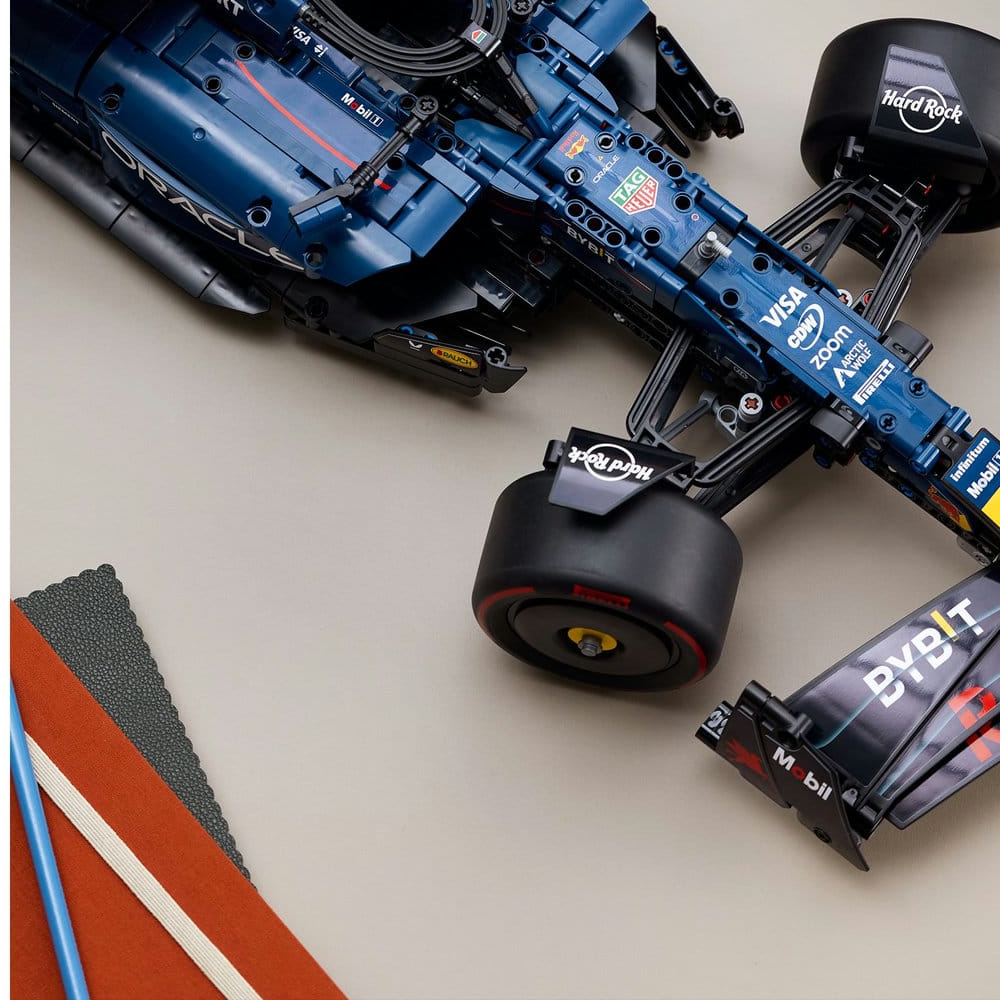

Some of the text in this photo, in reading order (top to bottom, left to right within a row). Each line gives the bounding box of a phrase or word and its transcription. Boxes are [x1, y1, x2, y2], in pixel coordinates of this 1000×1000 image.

[341, 92, 373, 120] Mobil
[881, 89, 963, 124] Hard Rock
[101, 130, 304, 271] ORACLE
[613, 171, 646, 202] TAG
[625, 177, 657, 213] HEUER
[758, 286, 808, 328] VISA
[787, 312, 818, 349] CDW
[809, 325, 853, 371] zoom
[841, 338, 868, 369] ARCTIC
[850, 348, 873, 372] WOLF
[852, 358, 896, 406] PIRELLI
[567, 446, 655, 481] Hard Rock
[950, 436, 991, 482] infinitum
[966, 461, 1000, 499] Mobil
[862, 597, 985, 709] BYBIT
[772, 746, 833, 801] Mobil
